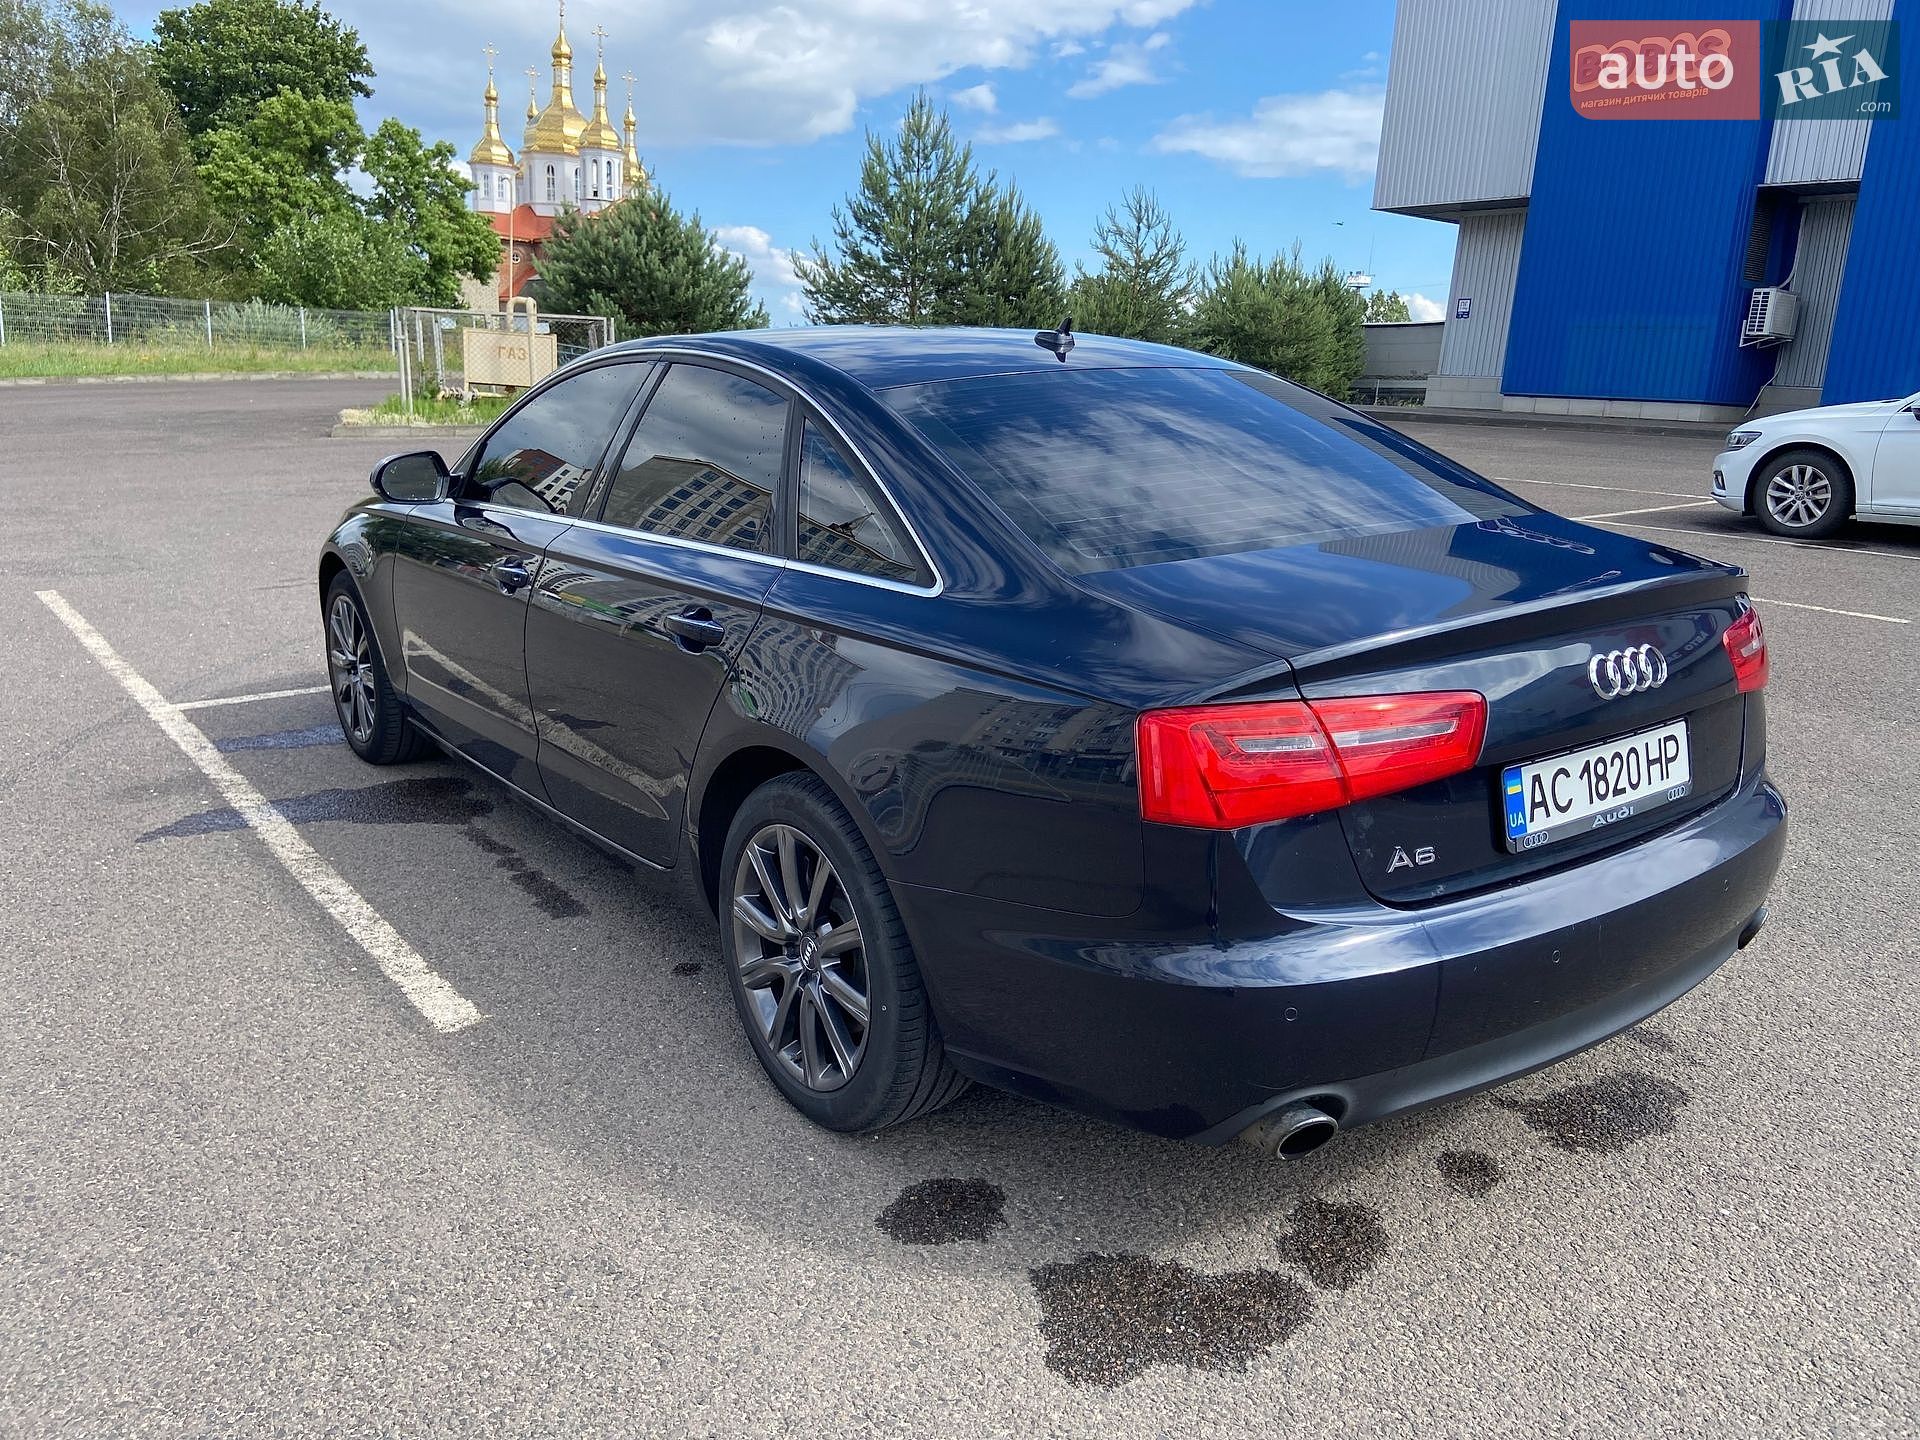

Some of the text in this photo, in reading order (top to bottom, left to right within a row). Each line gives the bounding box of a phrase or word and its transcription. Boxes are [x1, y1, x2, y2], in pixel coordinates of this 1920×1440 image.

[497, 346, 528, 360] ГАЗ
[1529, 734, 1680, 823] AC 1820 HP
[1510, 811, 1525, 828] UA
[1592, 805, 1634, 828] Audi
[1386, 846, 1436, 874] A6
